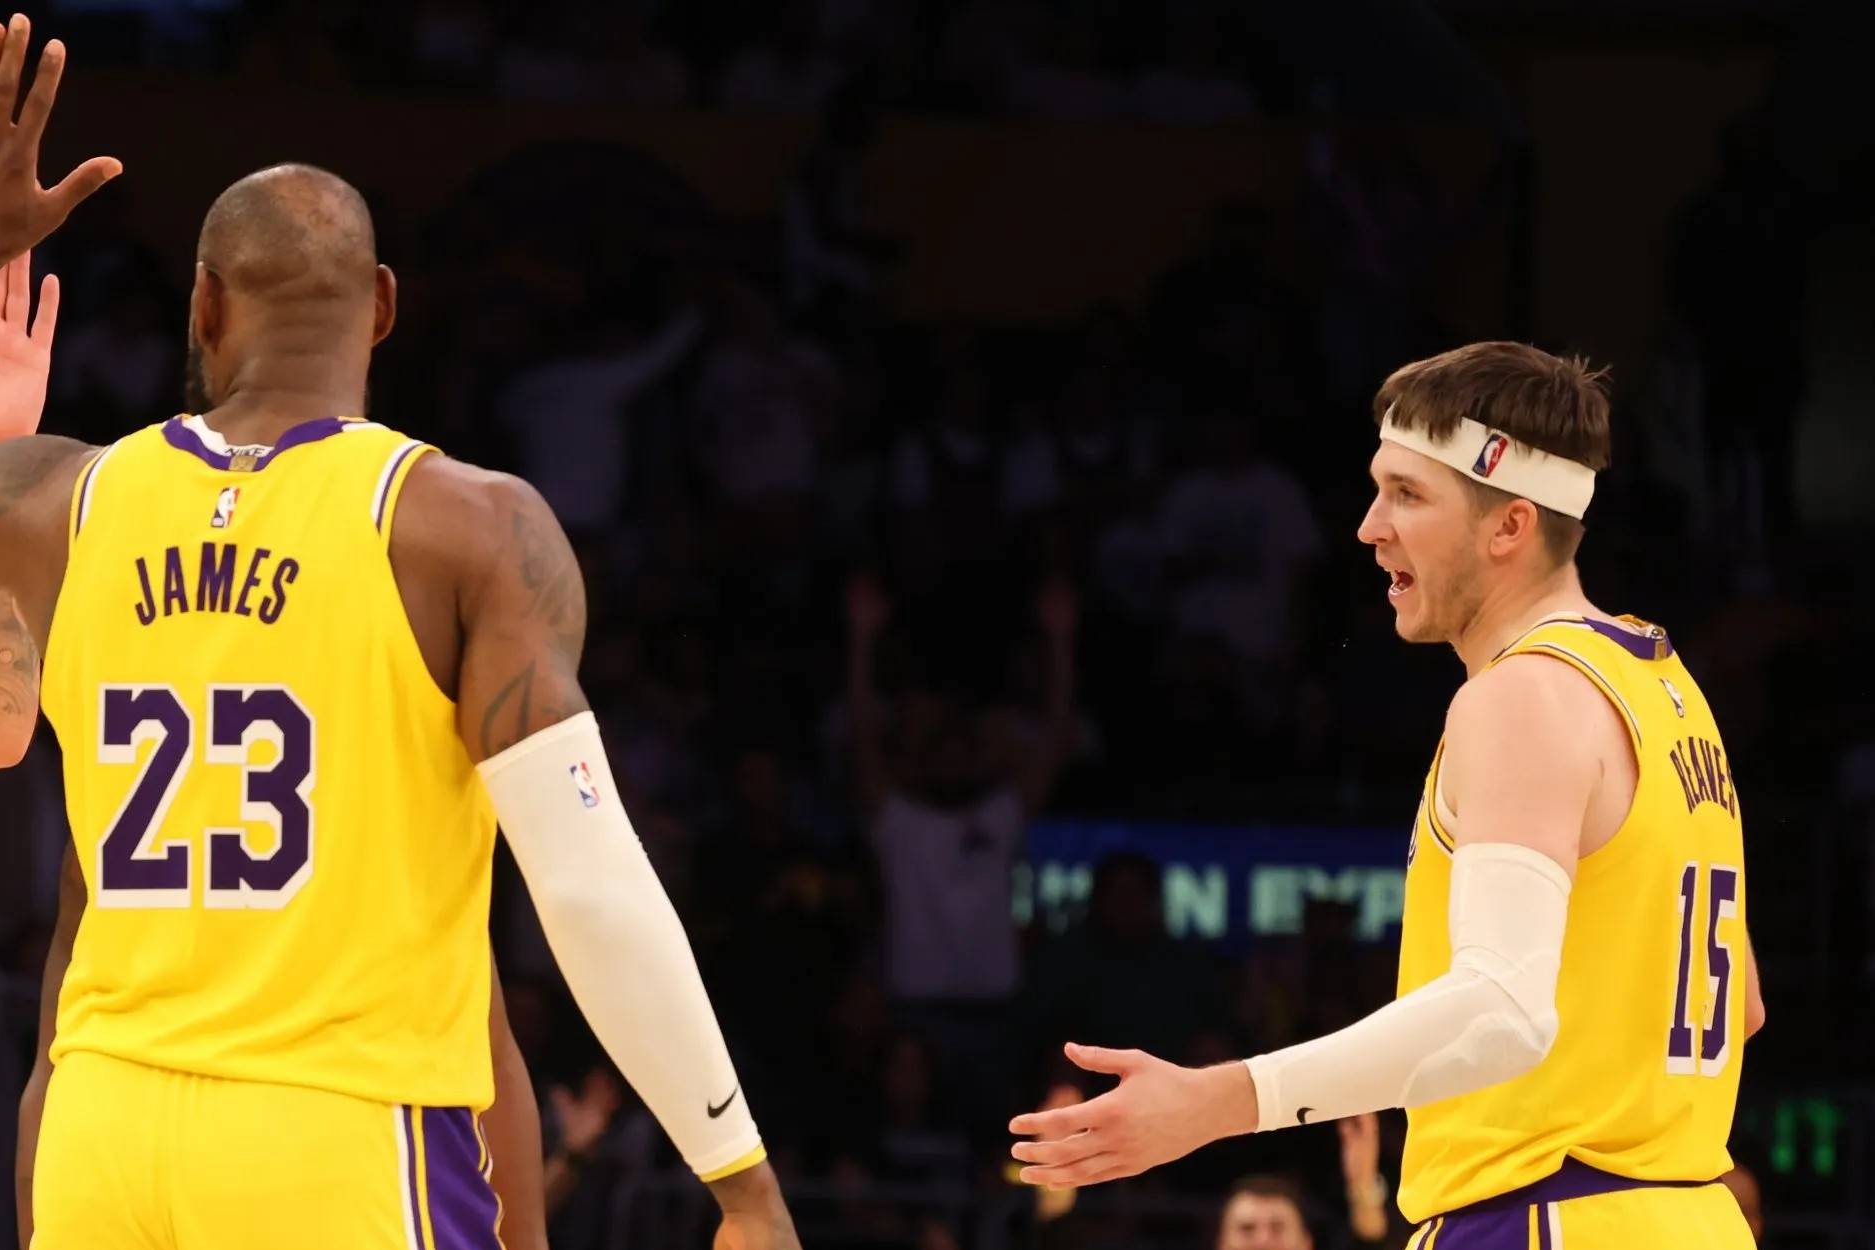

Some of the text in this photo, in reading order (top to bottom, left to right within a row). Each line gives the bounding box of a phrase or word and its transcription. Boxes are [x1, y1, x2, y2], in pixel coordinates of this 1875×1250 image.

[134, 542, 301, 627] JAMES
[96, 683, 317, 909] 23
[1666, 860, 1740, 1077] 15
